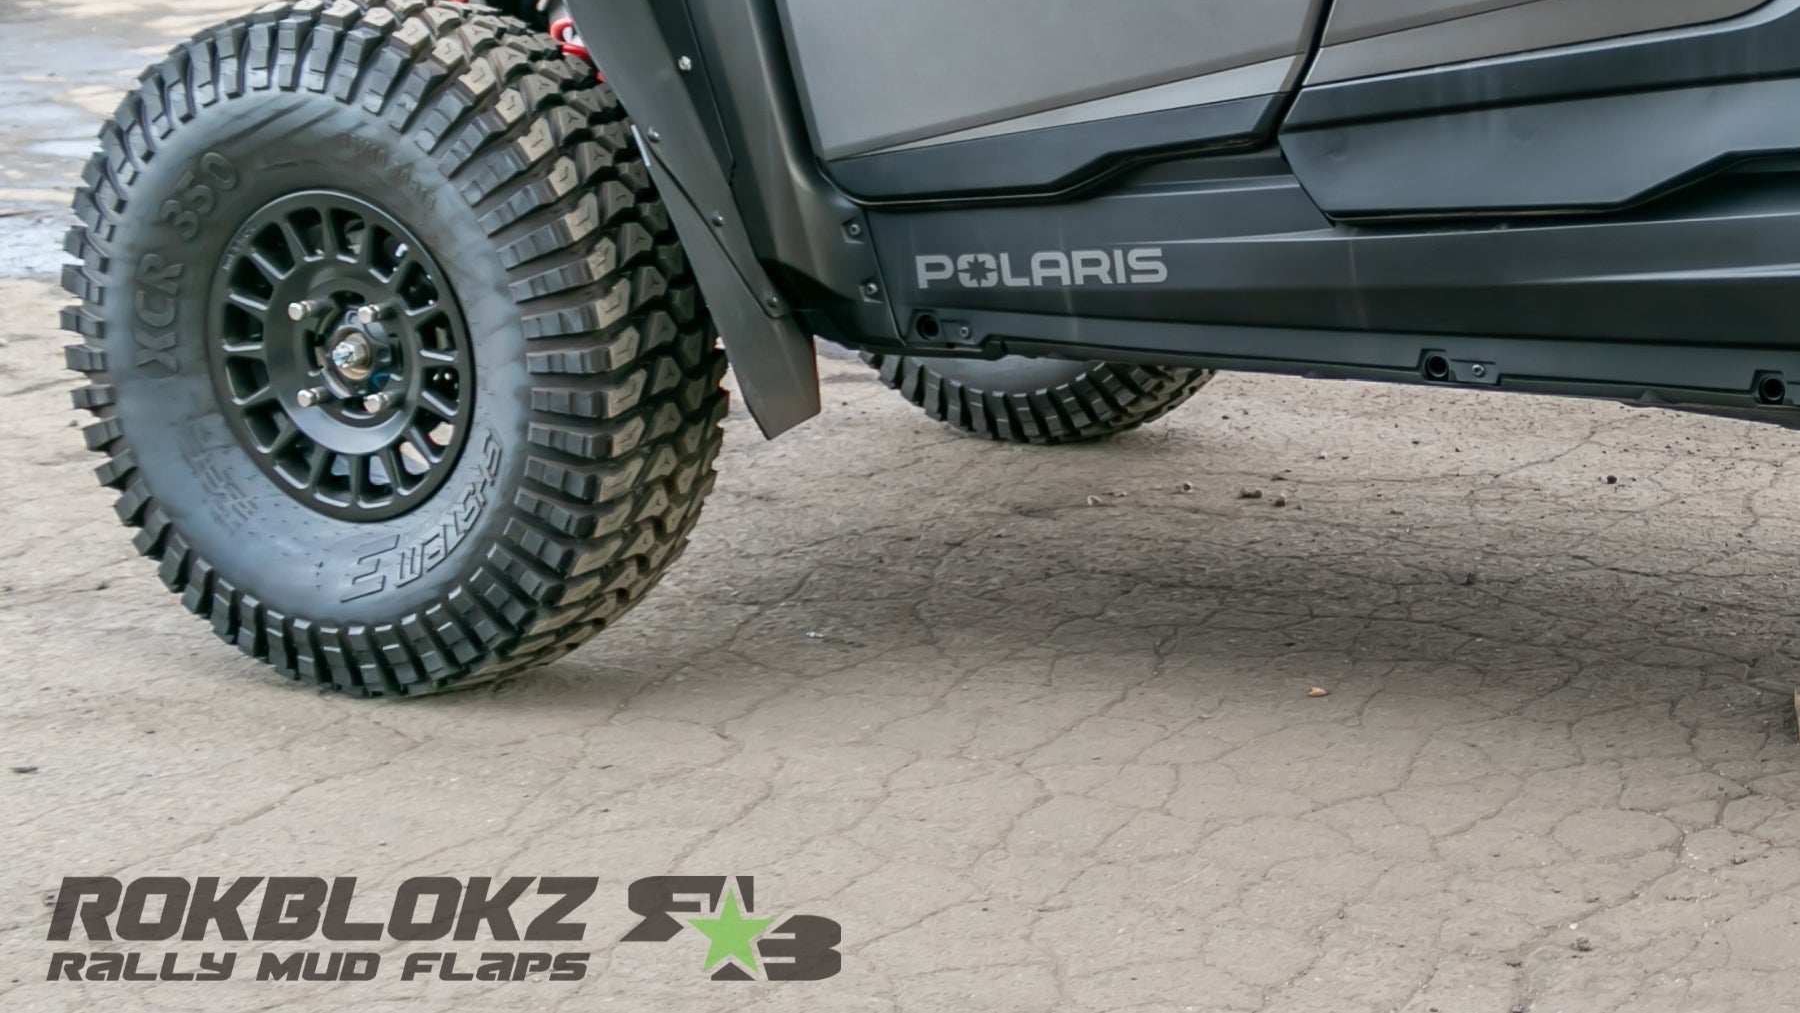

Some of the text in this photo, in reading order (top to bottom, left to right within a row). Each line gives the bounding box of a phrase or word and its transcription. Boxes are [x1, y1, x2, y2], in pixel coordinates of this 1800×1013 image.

[133, 151, 237, 374] XCR 350
[915, 247, 1168, 289] POLARIS
